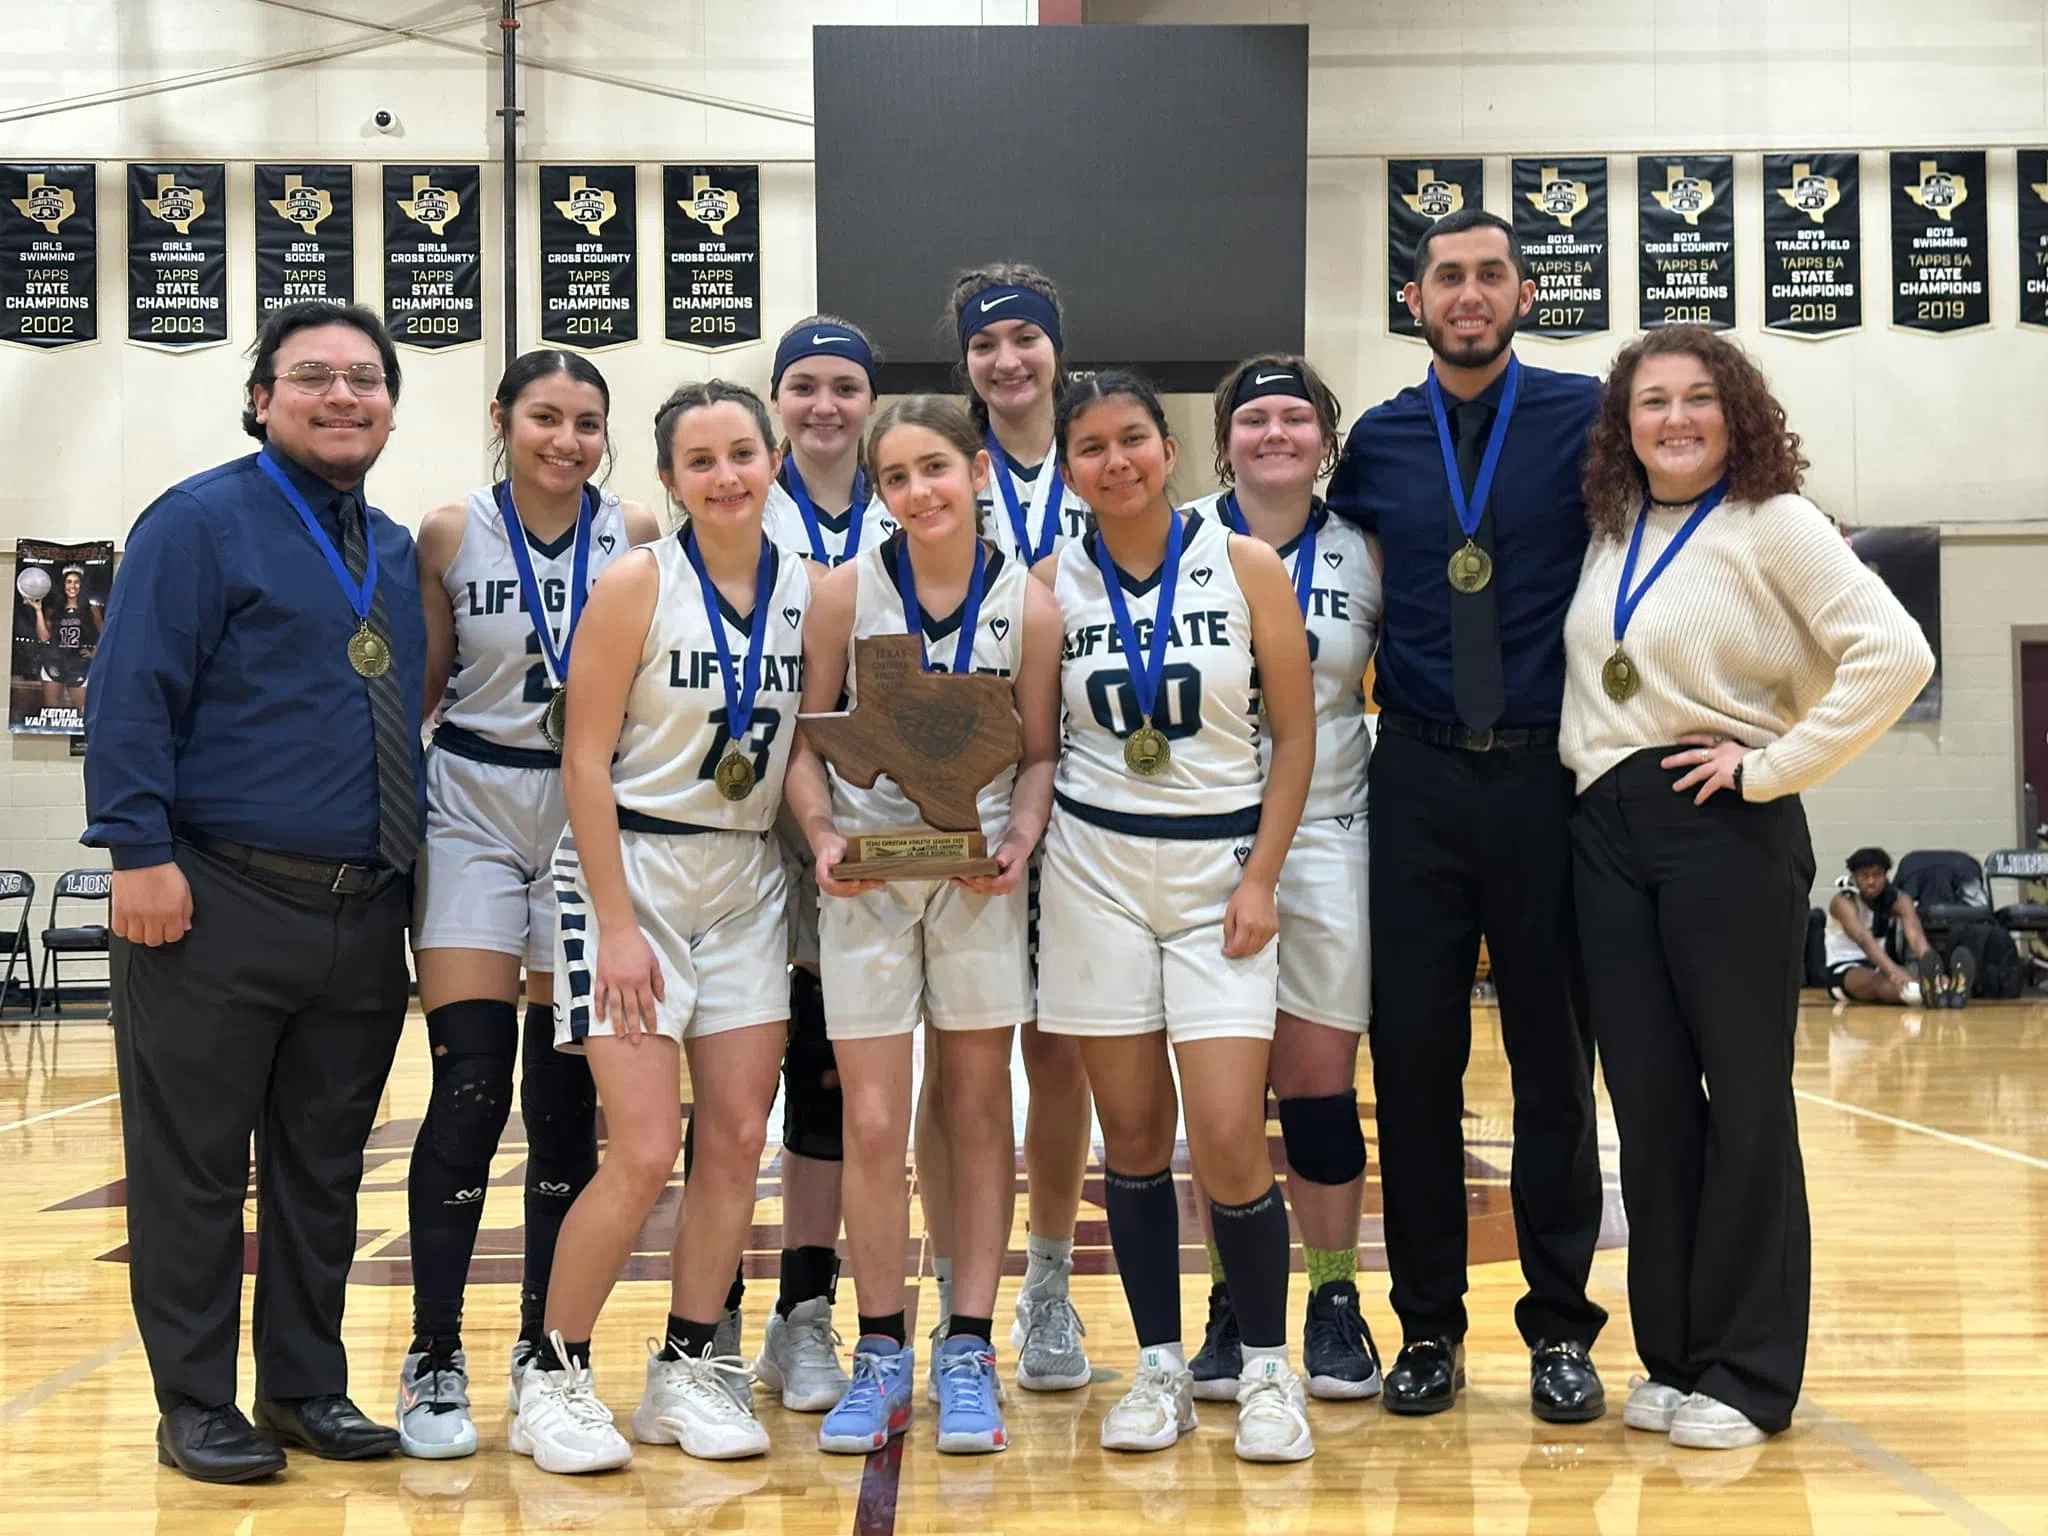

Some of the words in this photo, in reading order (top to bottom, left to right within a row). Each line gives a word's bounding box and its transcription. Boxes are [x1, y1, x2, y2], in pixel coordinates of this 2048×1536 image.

[31, 200, 63, 209] CHRISTIAN
[161, 200, 192, 208] CHRISTIAN
[288, 201, 320, 210] CHRISTIAN
[417, 201, 448, 210] CHRISTIAN
[573, 201, 604, 210] CHRISTIAN
[696, 201, 727, 210] CHRISTIAN
[1673, 232, 1700, 243] BOYS
[1798, 230, 1825, 239] BOYS
[1927, 228, 1953, 237] BOYS
[1548, 235, 1574, 244] BOYS
[1776, 241, 1809, 250] TRACK
[1821, 240, 1850, 250] FIELD
[1913, 238, 1967, 248] SWIMMING
[33, 242, 62, 250] GIRLS
[163, 242, 192, 251] GIRLS
[292, 243, 318, 252] BOYS
[418, 243, 447, 252] GIRLS
[576, 244, 602, 252] BOYS
[699, 243, 725, 252] BOYS
[1645, 243, 1678, 253] CROSS
[20, 253, 75, 261] SWIMMING
[150, 253, 205, 261] SWIMMING
[285, 253, 325, 262] SOCCER
[391, 254, 424, 262] CROSS
[548, 254, 581, 263] CROSS
[672, 253, 704, 262] CROSS
[1909, 254, 1951, 266] TAPPS
[1530, 261, 1571, 273] TAPPS
[1656, 259, 1697, 271] TAPPS
[1782, 257, 1823, 269] TAPPS
[26, 269, 68, 280] TAPPS
[156, 269, 198, 280] TAPPS
[284, 270, 326, 281] TAPPS
[412, 270, 453, 282] TAPPS
[568, 271, 610, 281] TAPPS
[692, 270, 733, 280] TAPPS
[1666, 273, 1708, 285] STATE
[1792, 270, 1834, 283] STATE
[1920, 268, 1961, 280] STATE
[1540, 275, 1582, 287] STATE
[26, 283, 68, 294] STATE
[156, 283, 199, 295] STATE
[284, 284, 326, 295] STATE
[412, 284, 453, 295] STATE
[569, 284, 610, 296] STATE
[692, 283, 733, 295] STATE
[1647, 286, 1728, 299] CHAMPIONS
[1772, 284, 1853, 297] CHAMPIONS
[1900, 282, 1981, 295] CHAMPIONS
[1534, 288, 1601, 301] HAMPIONS
[6, 297, 88, 308] CHAMPIONS
[137, 297, 218, 309] CHAMPIONS
[392, 298, 473, 310] CHAMPIONS
[550, 298, 629, 310] CHAMPIONS
[673, 297, 752, 309] CHAMPIONS
[1663, 306, 1711, 323] 2018
[1789, 304, 1836, 322] 2019
[1918, 301, 1964, 319] 2019
[1539, 308, 1584, 325] 2017
[21, 317, 73, 333] 2002
[151, 317, 204, 333] 2003
[407, 317, 458, 333] 2009
[567, 318, 613, 334] 2014
[691, 317, 735, 332] 2015
[59, 627, 81, 648] 12
[1085, 662, 1203, 742] 00
[40, 708, 77, 718] KENNA
[25, 717, 47, 727] VAN
[51, 718, 84, 728] WINKL
[66, 874, 111, 893] LION
